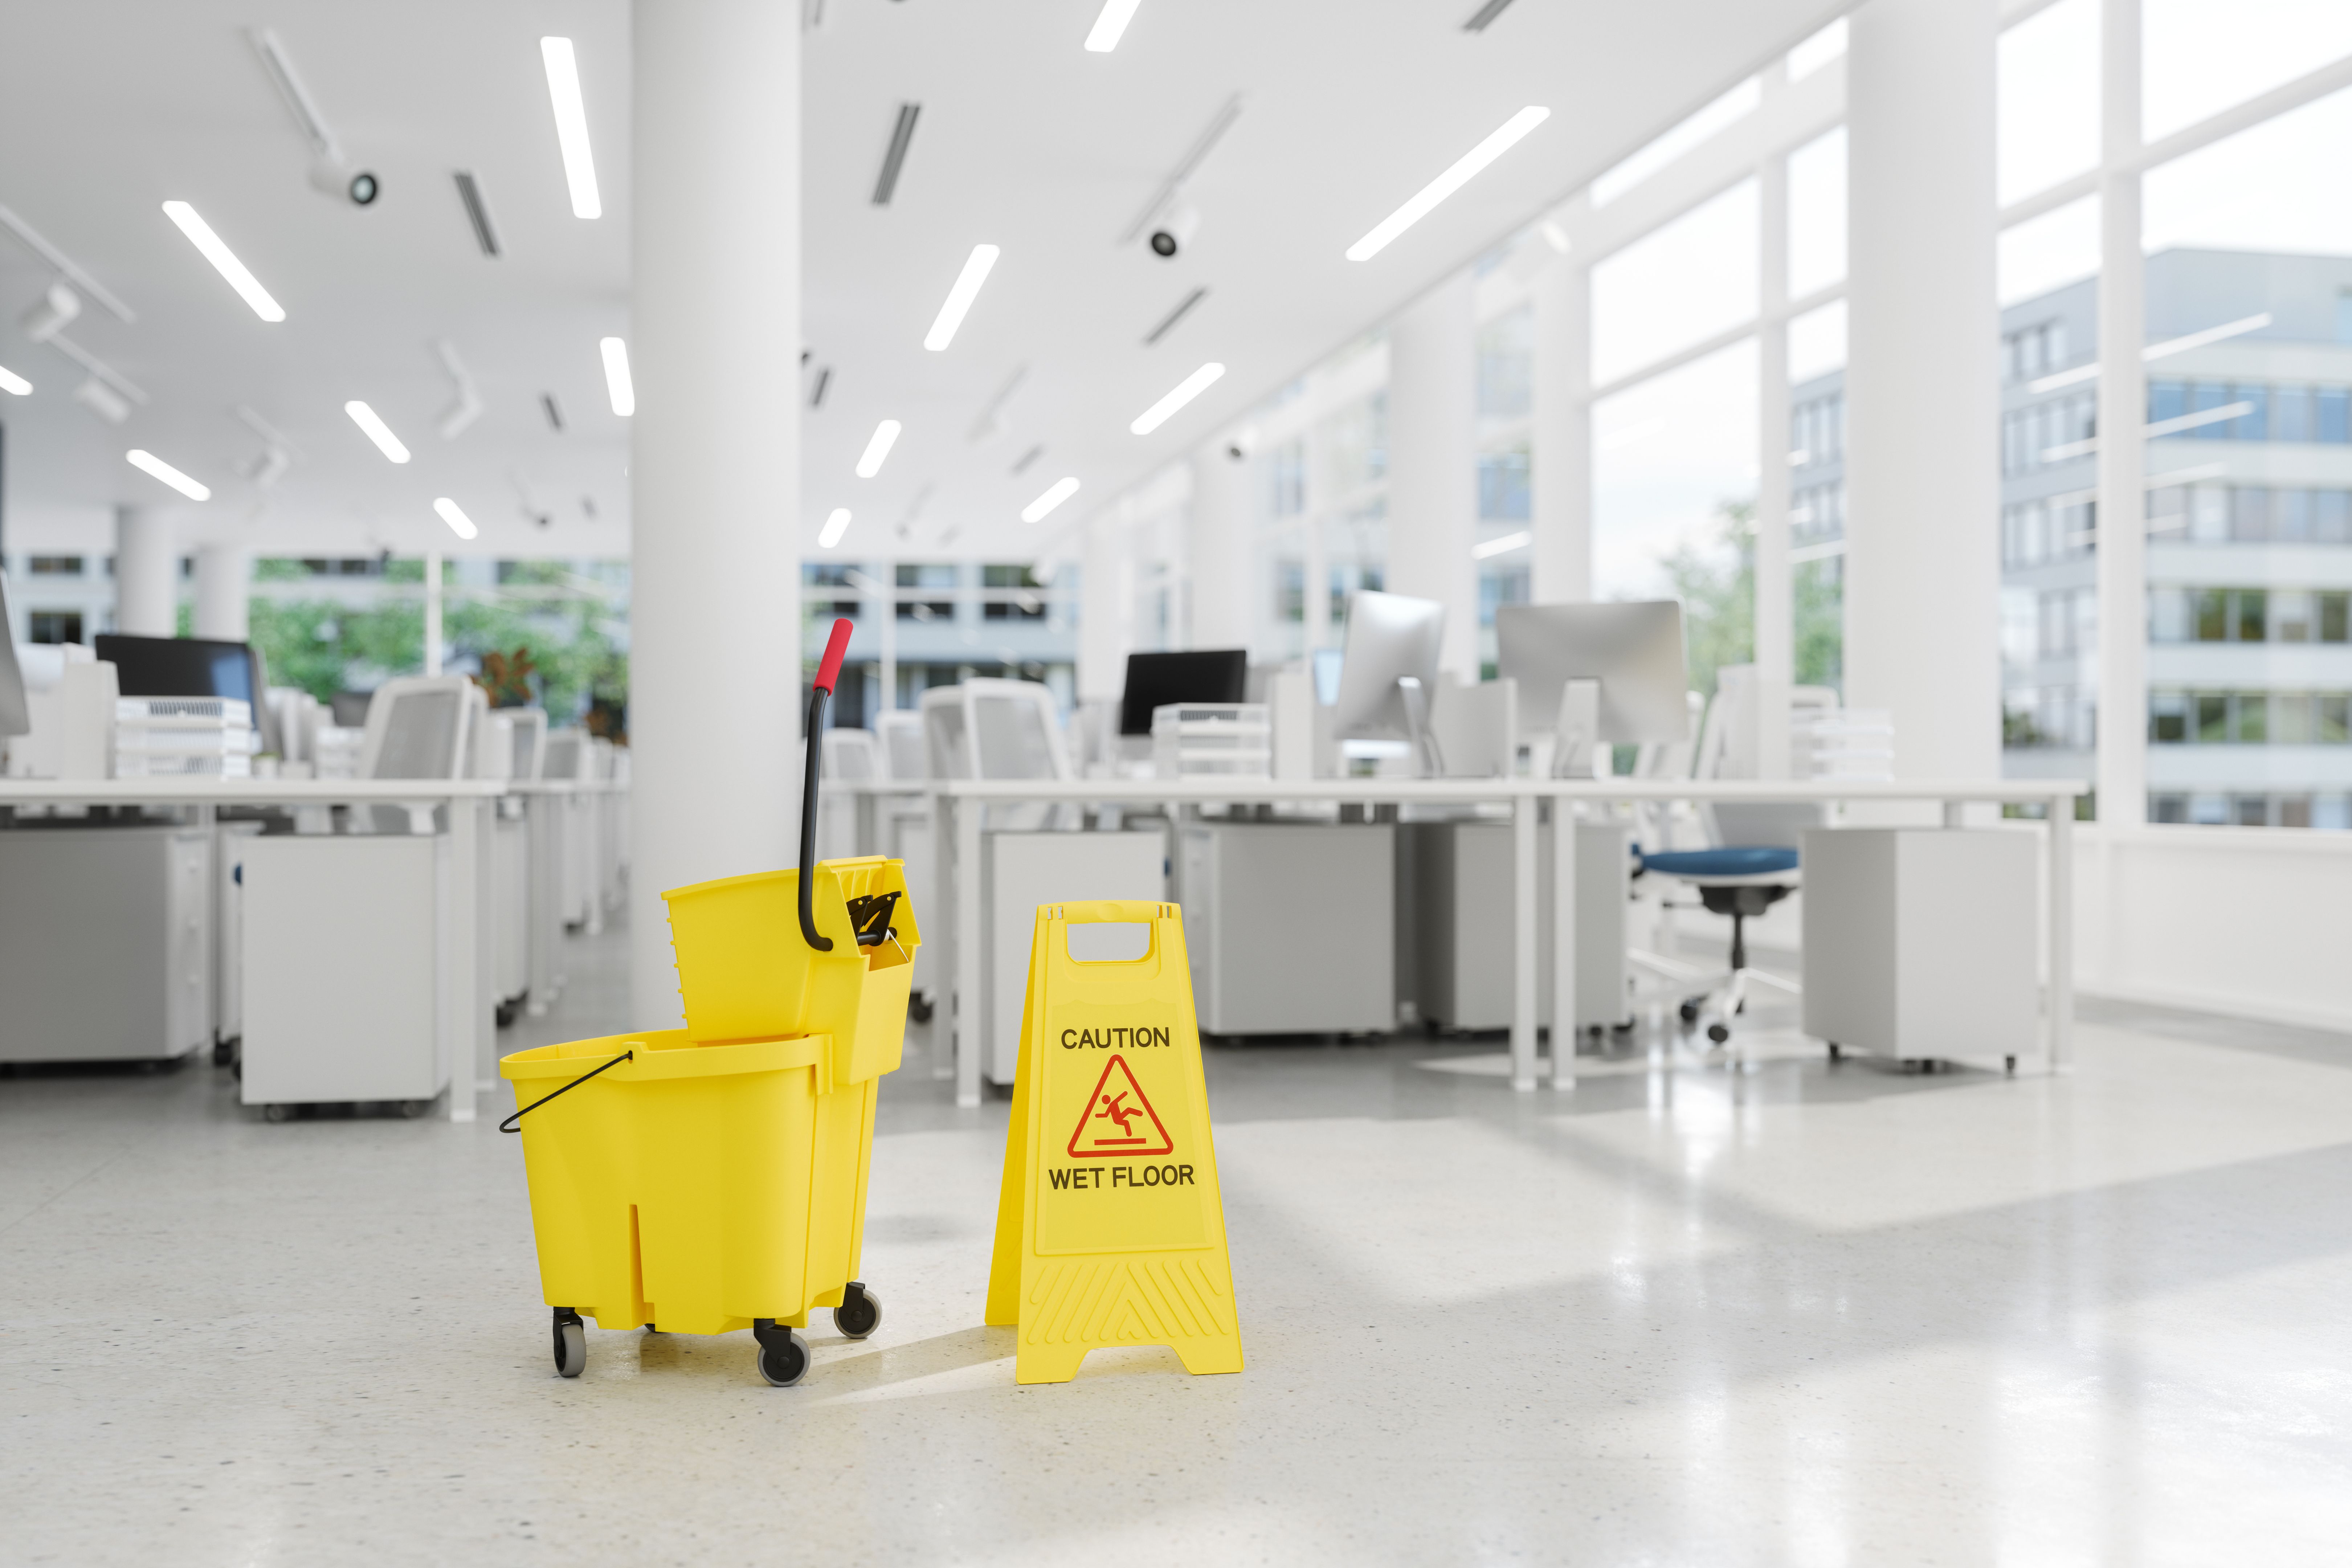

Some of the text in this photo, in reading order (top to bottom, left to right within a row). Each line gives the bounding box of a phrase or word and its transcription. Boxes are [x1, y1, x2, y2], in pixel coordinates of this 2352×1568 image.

[1061, 1027, 1170, 1049] CAUTION
[1048, 1164, 1195, 1190] WET FLOOR
